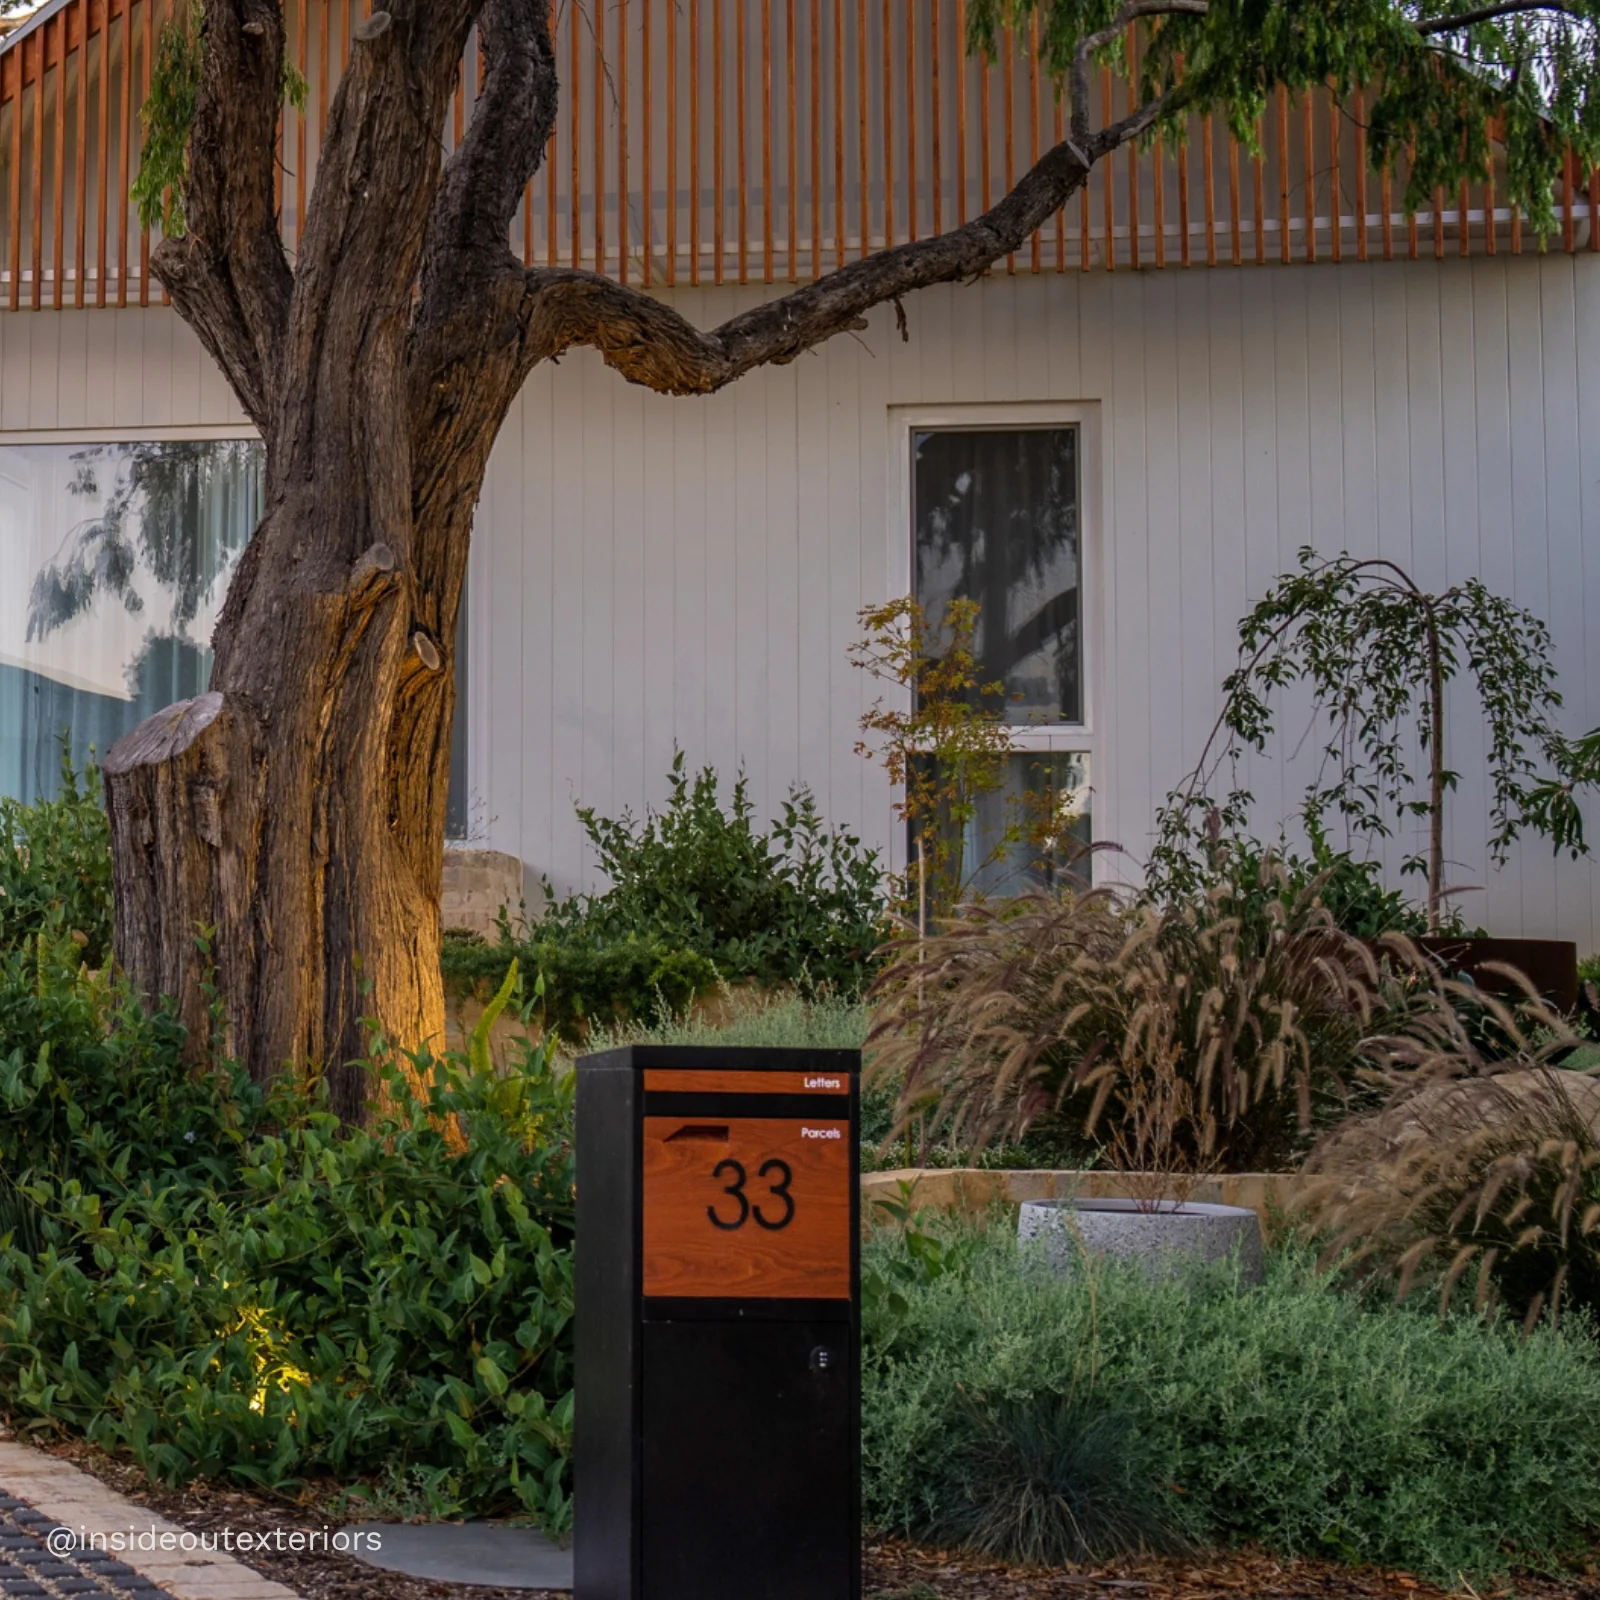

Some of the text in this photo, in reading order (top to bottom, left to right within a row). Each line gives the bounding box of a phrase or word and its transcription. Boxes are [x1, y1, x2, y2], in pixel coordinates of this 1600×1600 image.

[803, 1077, 841, 1089] Letters
[801, 1127, 841, 1139] Parcels
[707, 1159, 795, 1231] 33
